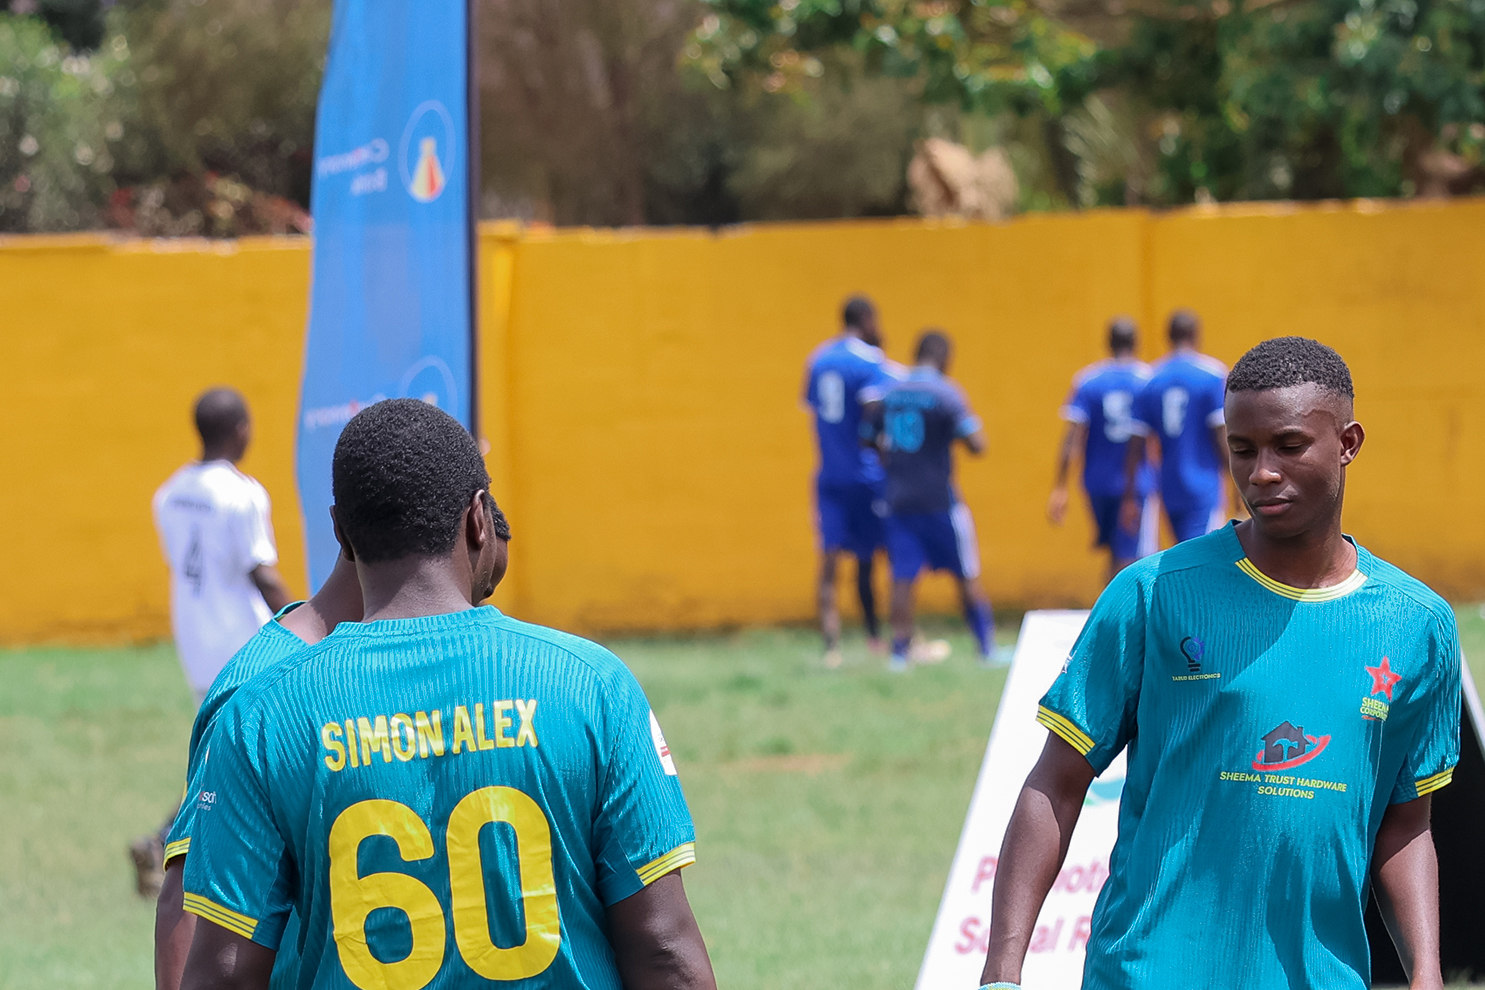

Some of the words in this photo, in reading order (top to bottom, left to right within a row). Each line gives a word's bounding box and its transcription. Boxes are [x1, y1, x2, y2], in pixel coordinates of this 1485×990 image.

[321, 710, 445, 772] SIMON
[452, 699, 538, 755] ALEX
[1219, 771, 1262, 783] SHEEMA
[1264, 774, 1296, 786] TRUST
[1296, 777, 1348, 793] HARDWARE
[1257, 786, 1315, 800] SOLUTIONS
